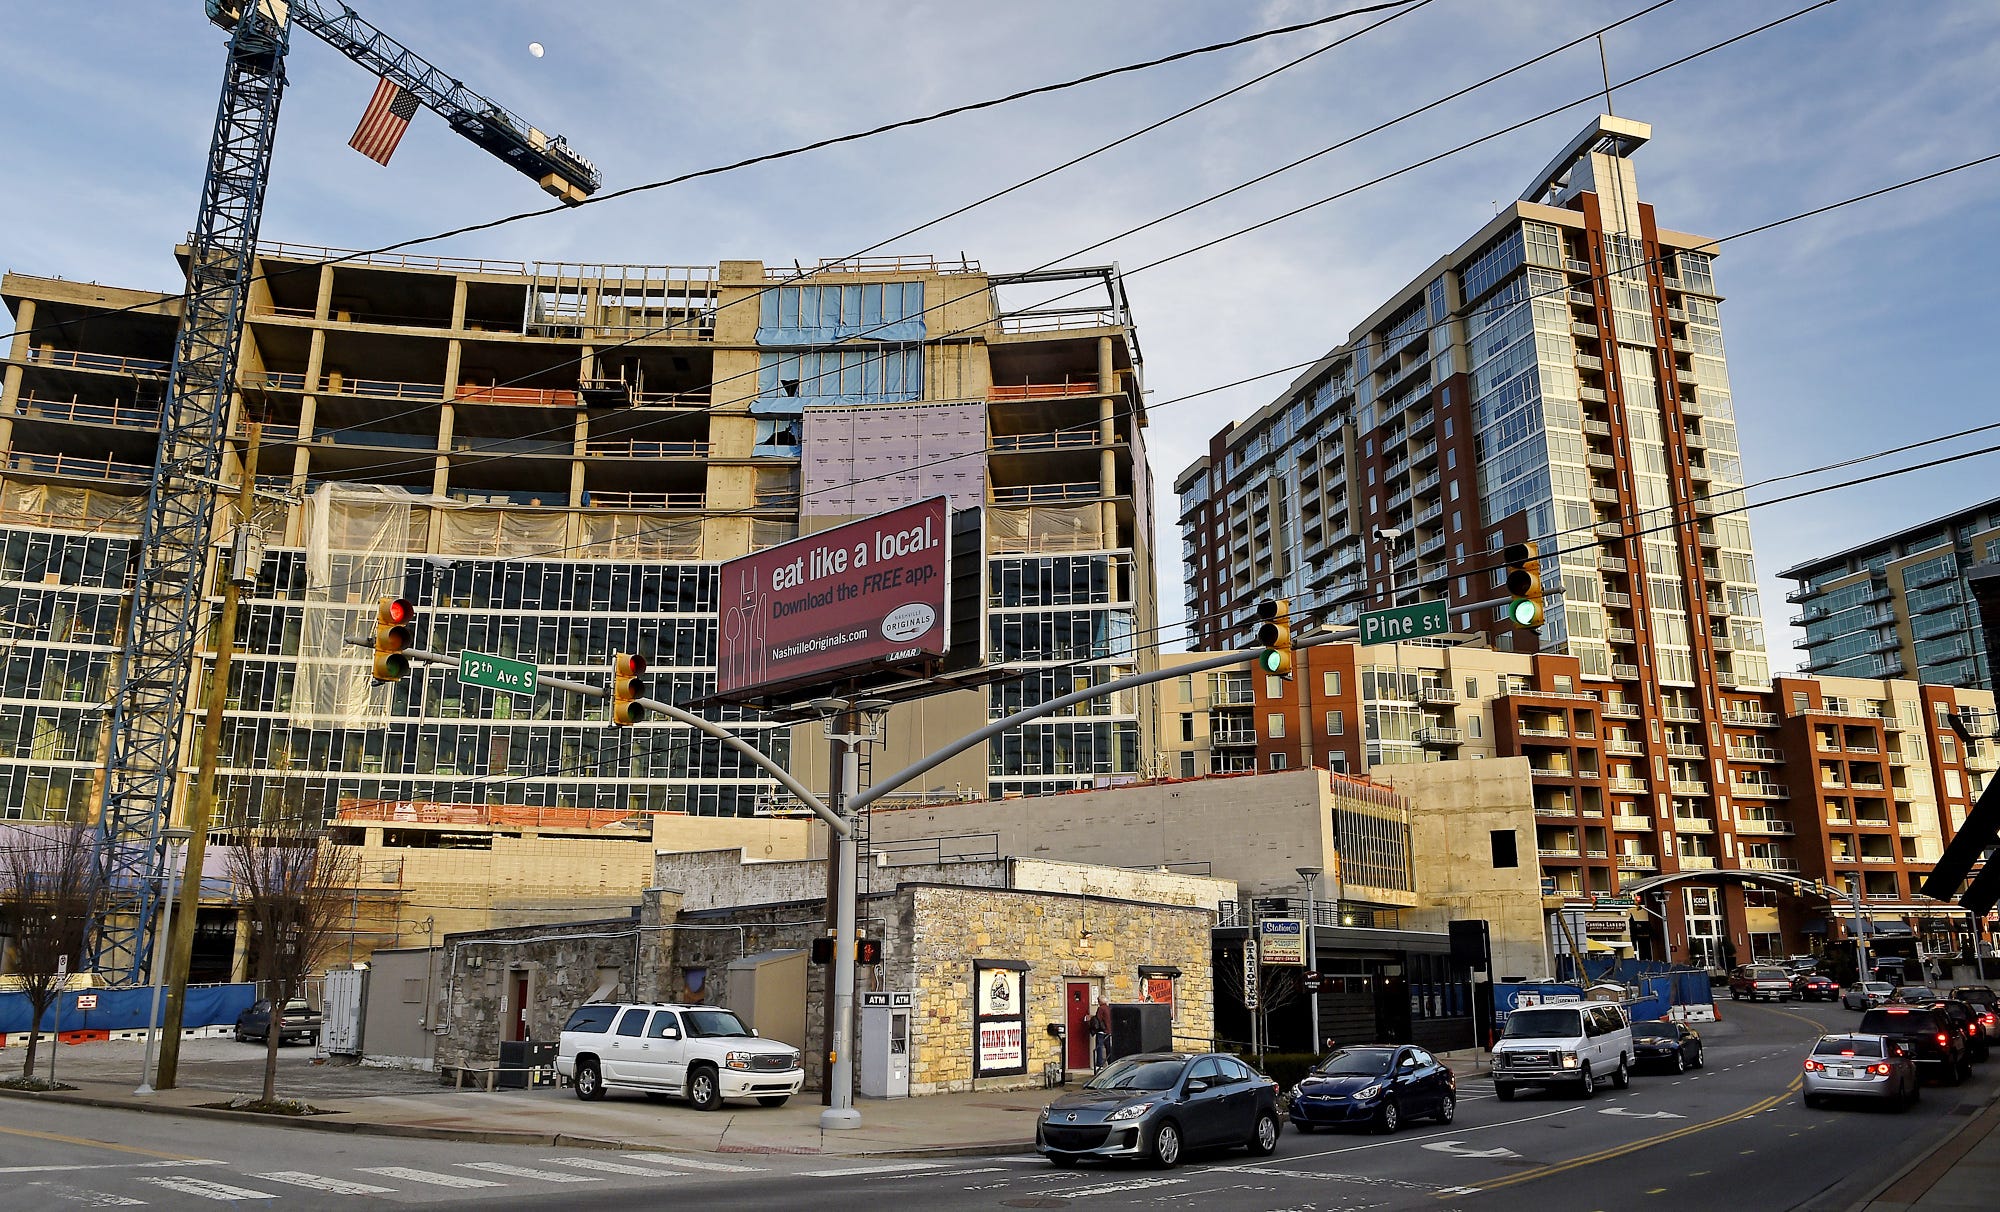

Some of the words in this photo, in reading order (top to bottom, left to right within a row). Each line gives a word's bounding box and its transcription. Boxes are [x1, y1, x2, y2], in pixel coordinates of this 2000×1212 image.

[772, 556, 804, 591] eat
[809, 546, 848, 581] like
[853, 542, 868, 568] a
[875, 516, 939, 563] local.
[773, 586, 834, 619] Download
[836, 582, 859, 602] the
[862, 567, 903, 596] FREE
[905, 564, 938, 587] app.
[886, 615, 931, 632] ORIGINALS
[1366, 615, 1413, 640] Pine
[1423, 614, 1441, 631] St
[772, 629, 868, 661] NashvilleOriginals.com
[889, 648, 918, 661] LAMAR
[464, 659, 493, 678] 12th
[496, 669, 518, 685] Ave
[523, 671, 533, 688] S
[1266, 922, 1290, 933] Station
[1246, 941, 1255, 986] STATION
[868, 995, 886, 1004] ATM
[895, 995, 909, 1004] ATM
[1247, 986, 1256, 1007] INN
[981, 1029, 1006, 1049] THANK
[1007, 1029, 1021, 1047] YOU
